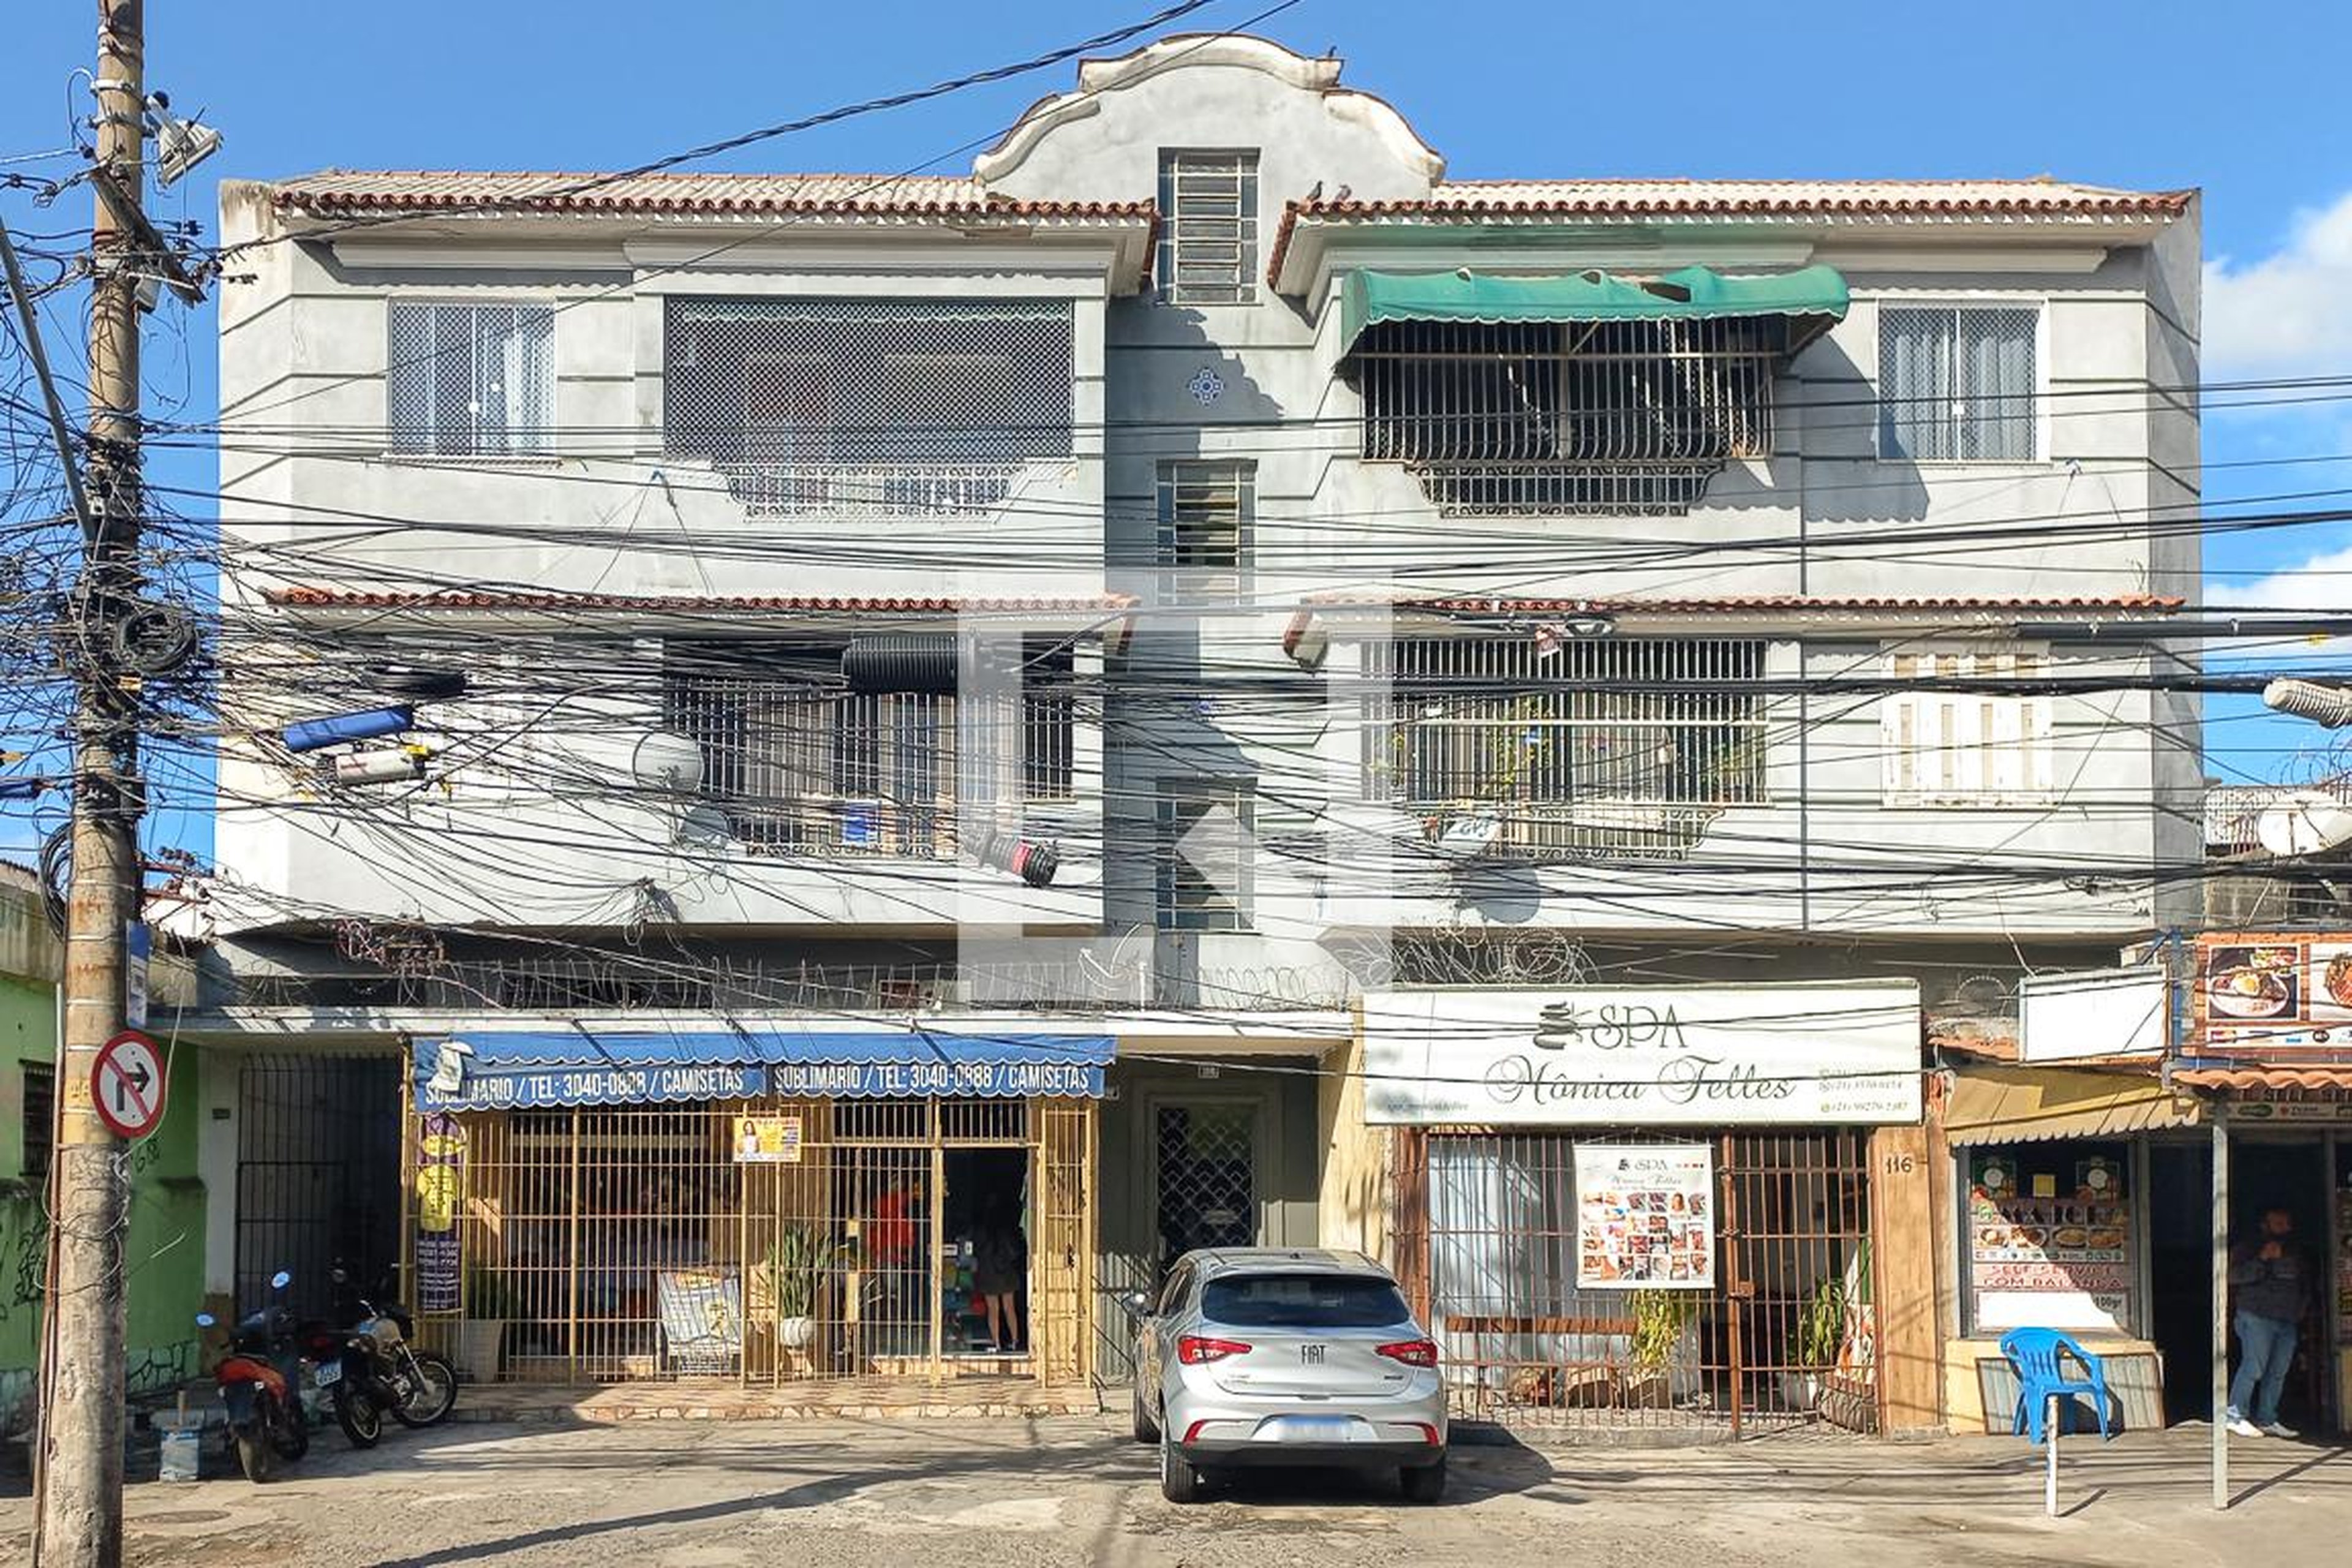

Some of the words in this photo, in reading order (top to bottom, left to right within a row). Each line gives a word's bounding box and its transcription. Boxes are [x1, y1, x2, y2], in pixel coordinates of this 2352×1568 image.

[1591, 1003, 1688, 1050] SPA
[662, 1066, 744, 1093] CAMISETAS
[774, 1065, 861, 1089] SUBLIMARIO
[1008, 1065, 1090, 1088] CAMISETAS
[1657, 1055, 1797, 1105] Telles
[1887, 1156, 1912, 1174] 116
[1301, 1344, 1327, 1365] FIAT
